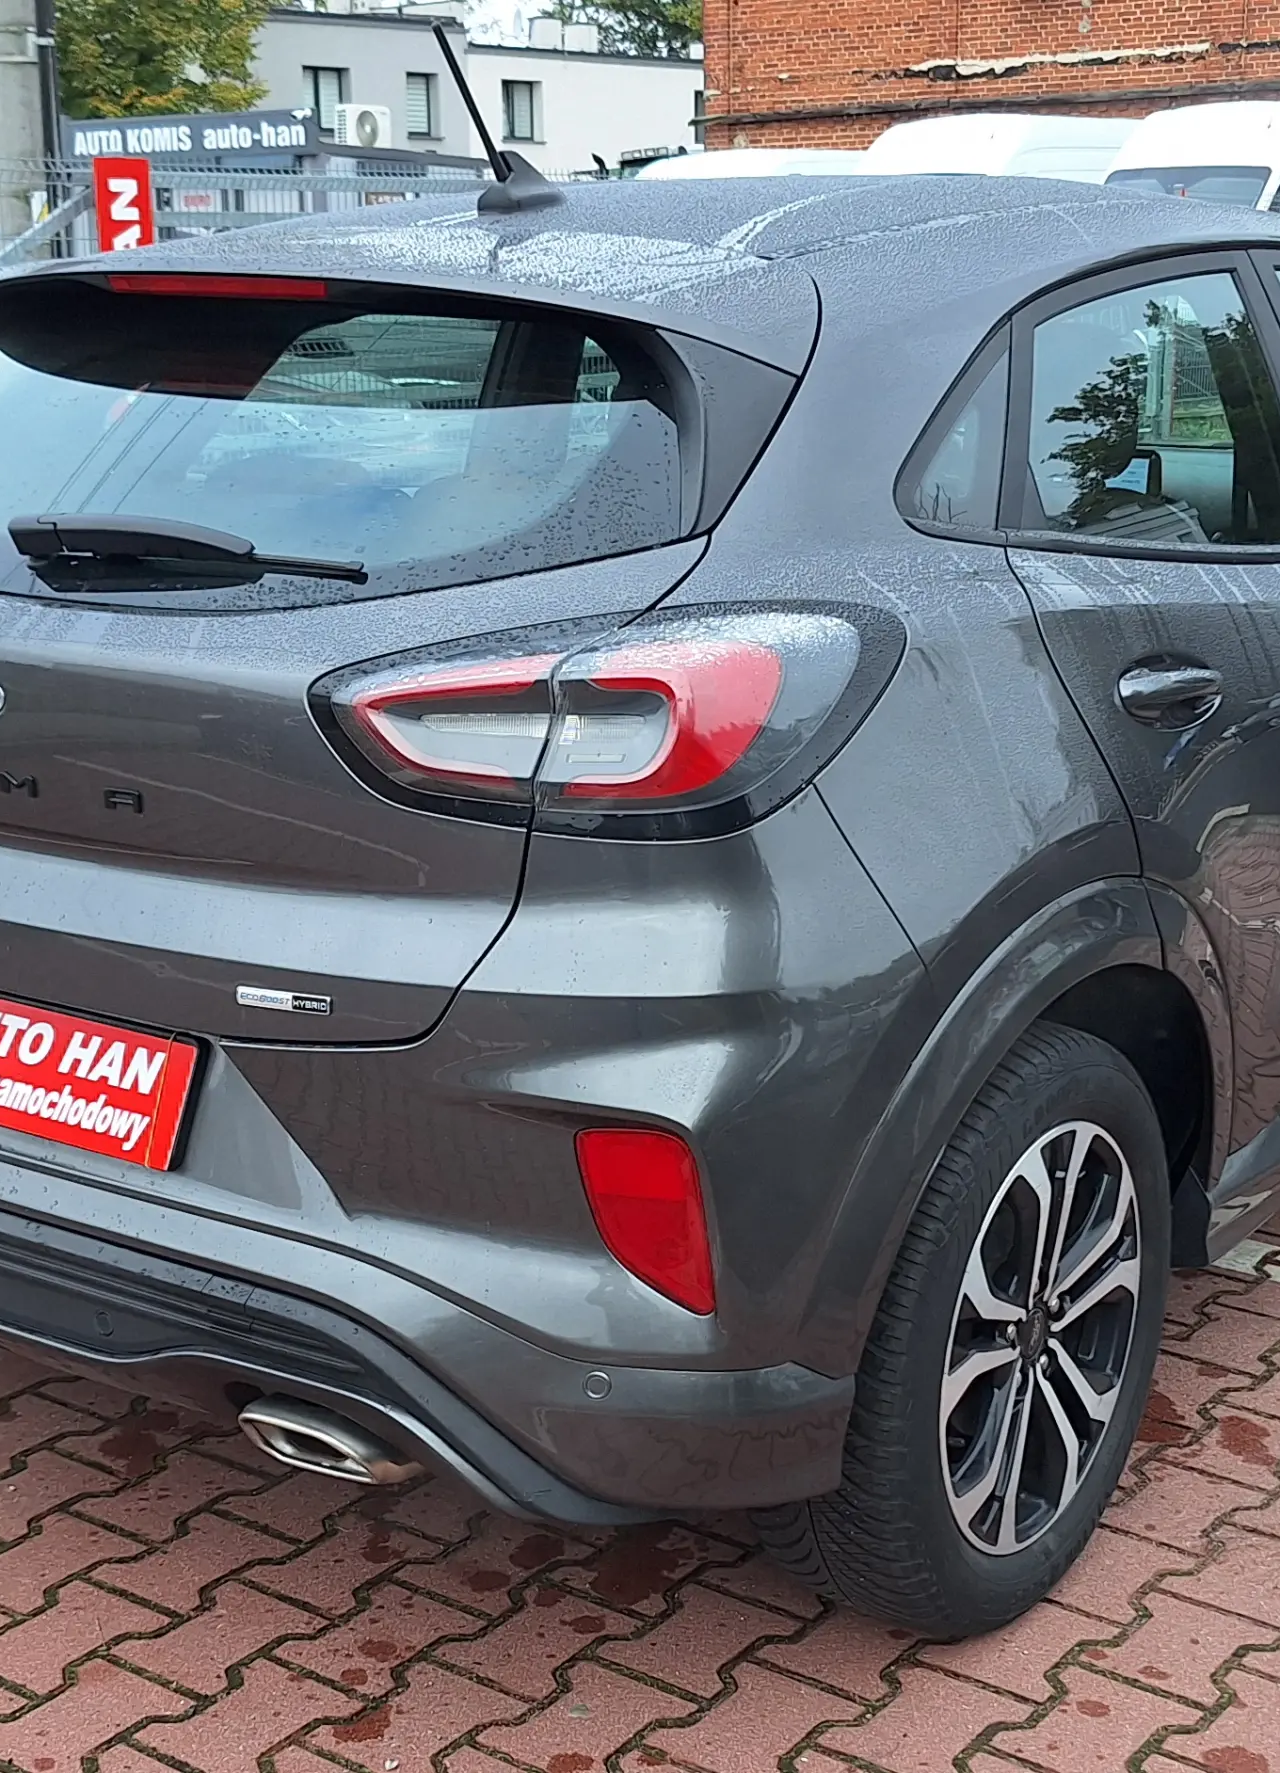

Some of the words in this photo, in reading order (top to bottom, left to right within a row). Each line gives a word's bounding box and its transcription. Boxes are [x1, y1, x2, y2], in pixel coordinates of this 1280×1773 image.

[74, 129, 121, 156] AUTO
[127, 126, 192, 154] KOMIS
[203, 121, 306, 150] auto-han
[293, 999, 327, 1011] HYBRID
[57, 1034, 166, 1095] HAN
